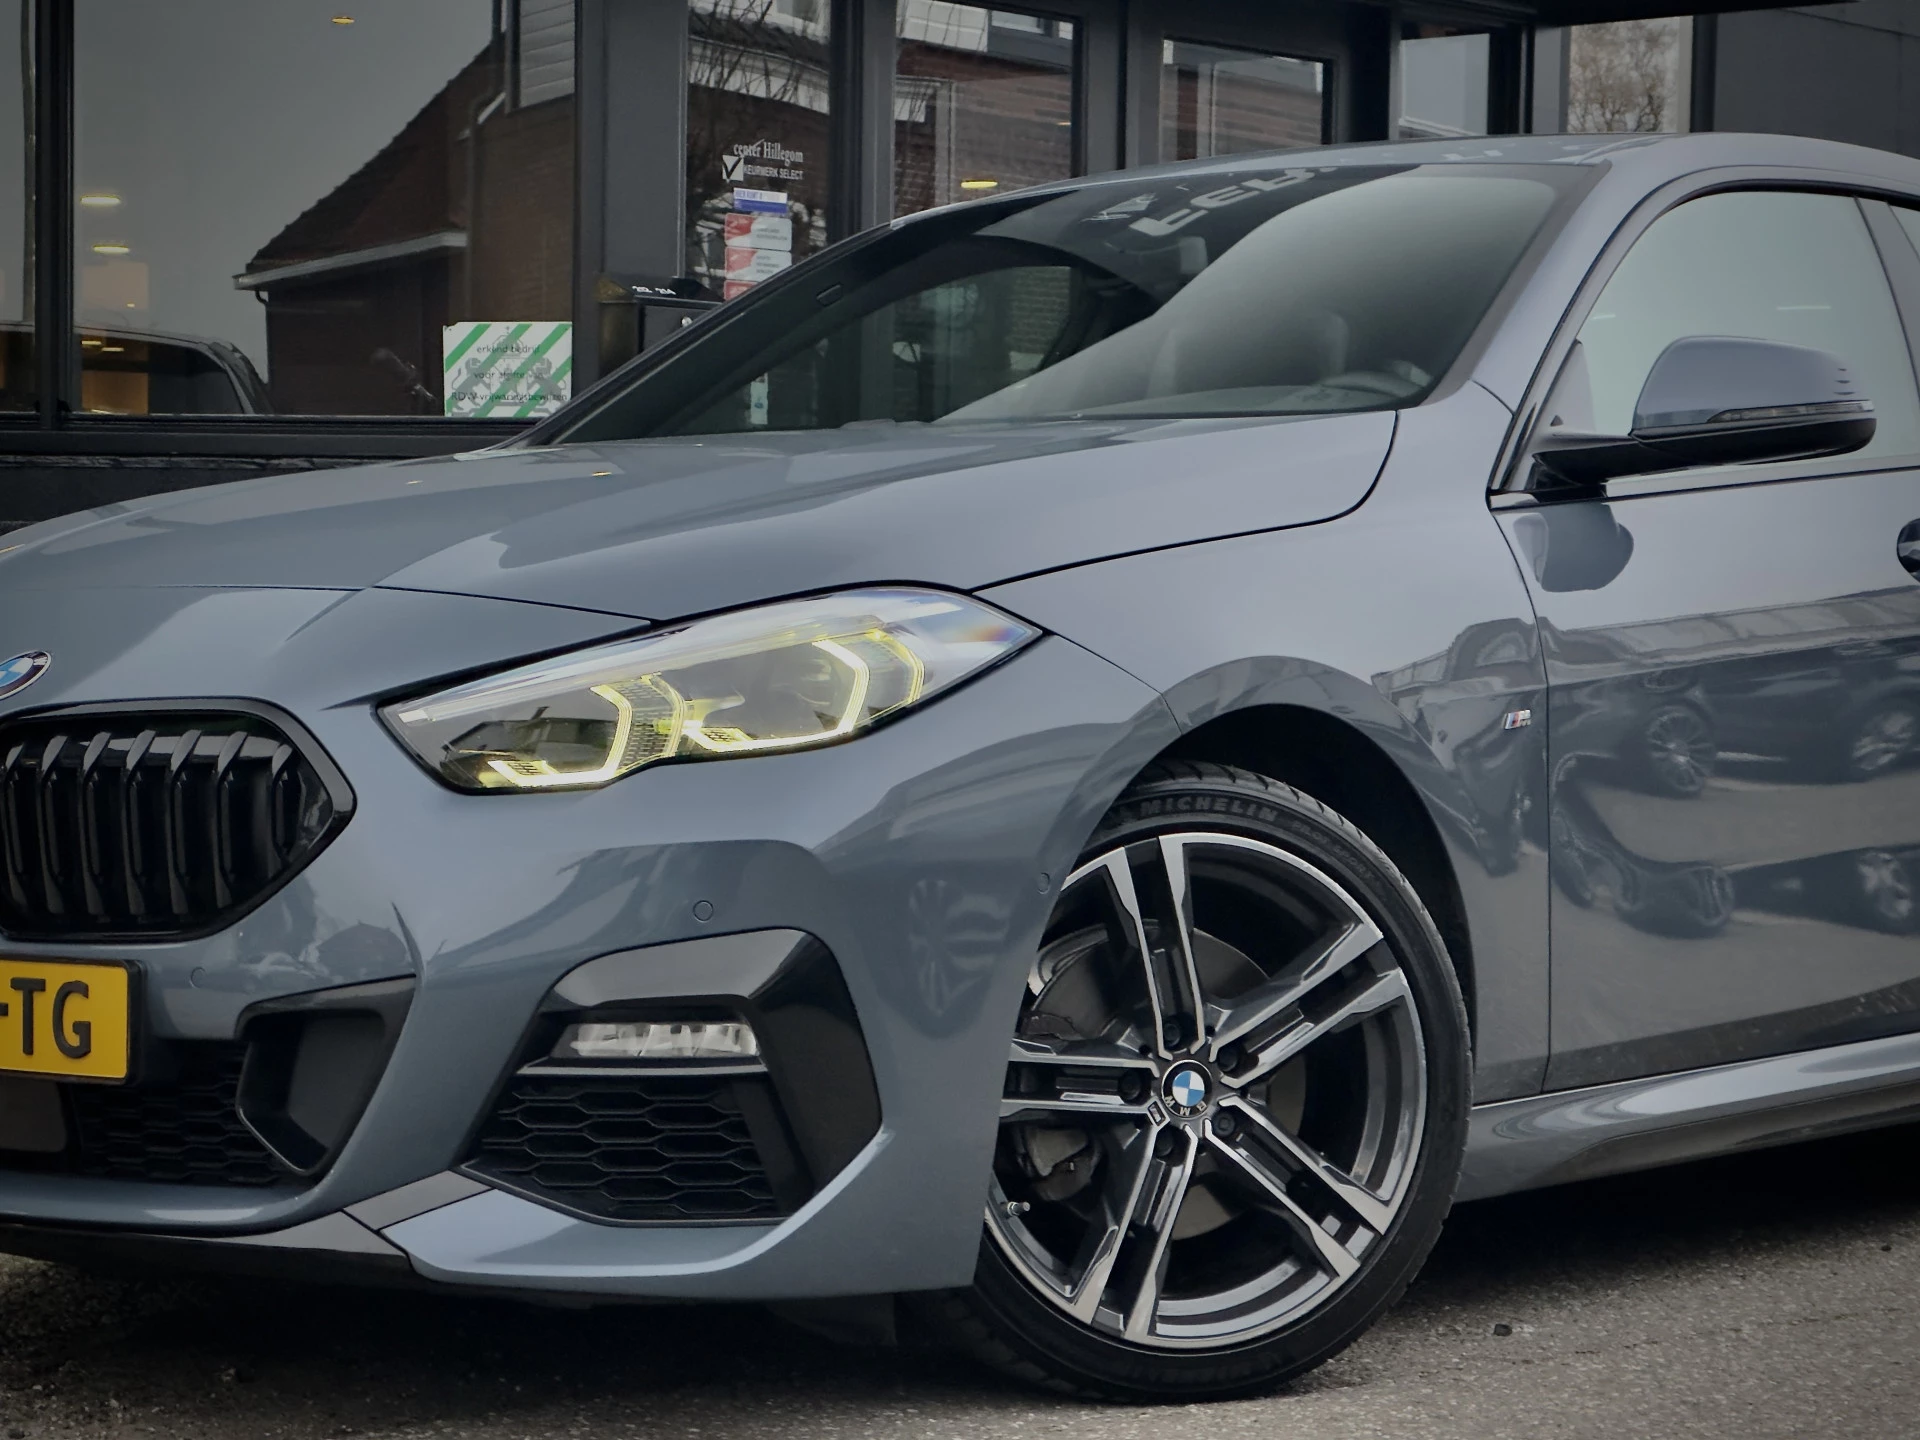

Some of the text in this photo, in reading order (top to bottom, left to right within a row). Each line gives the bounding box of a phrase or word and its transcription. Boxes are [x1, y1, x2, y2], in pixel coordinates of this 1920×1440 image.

[763, 142, 804, 167] Hillegom
[779, 168, 804, 180] SELECT
[476, 344, 540, 356] erkend bedrijf
[473, 371, 495, 380] voor
[1139, 798, 1279, 823] MICHELIN
[1164, 1095, 1208, 1117] BMW
